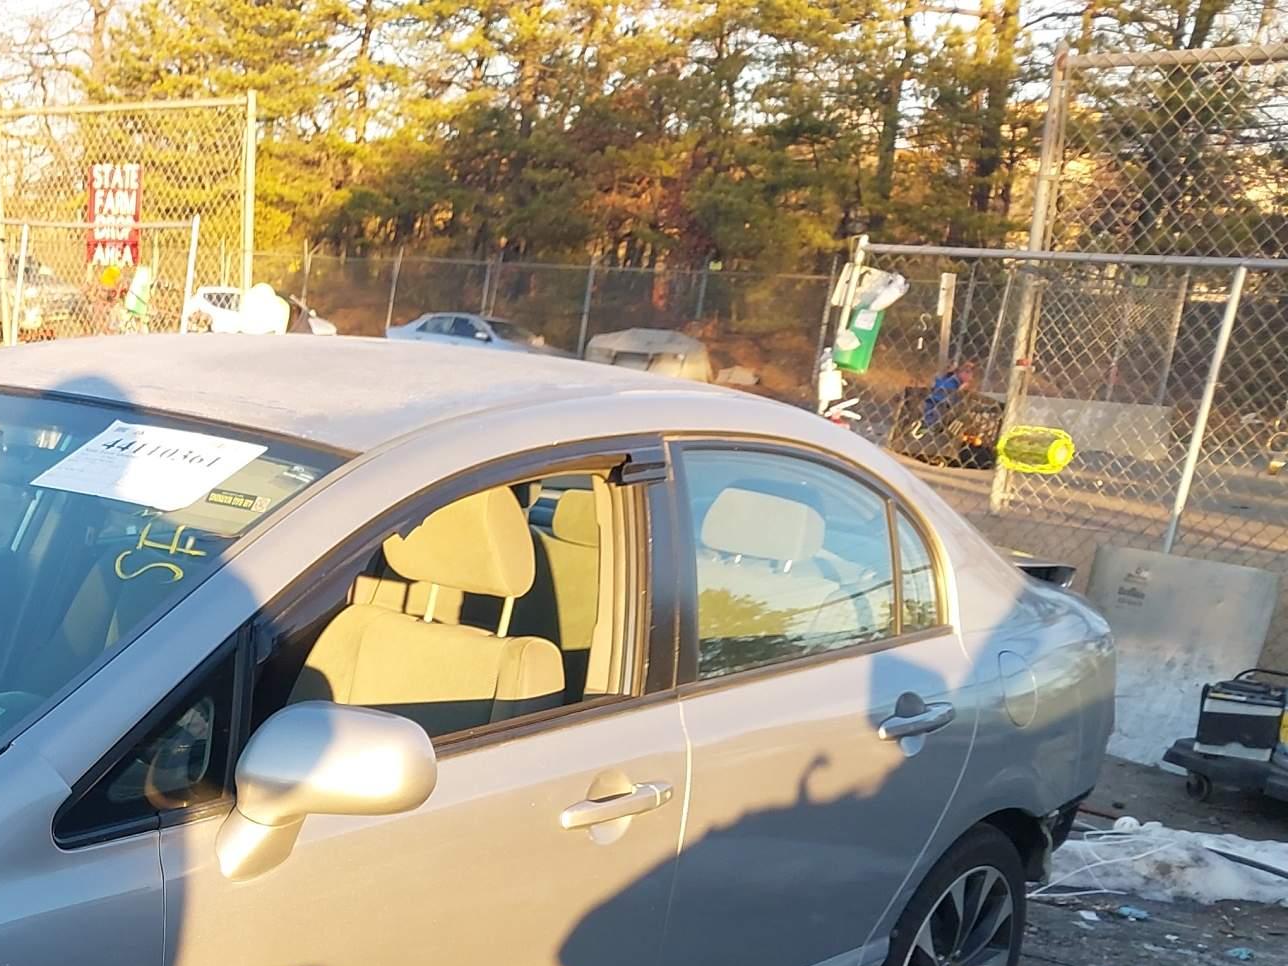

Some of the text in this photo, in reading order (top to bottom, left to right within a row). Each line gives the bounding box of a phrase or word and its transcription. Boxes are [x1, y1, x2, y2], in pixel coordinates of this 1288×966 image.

[93, 163, 139, 189] STATE
[94, 189, 137, 215] FARM
[92, 241, 134, 266] AREA
[103, 438, 222, 468] 44110361
